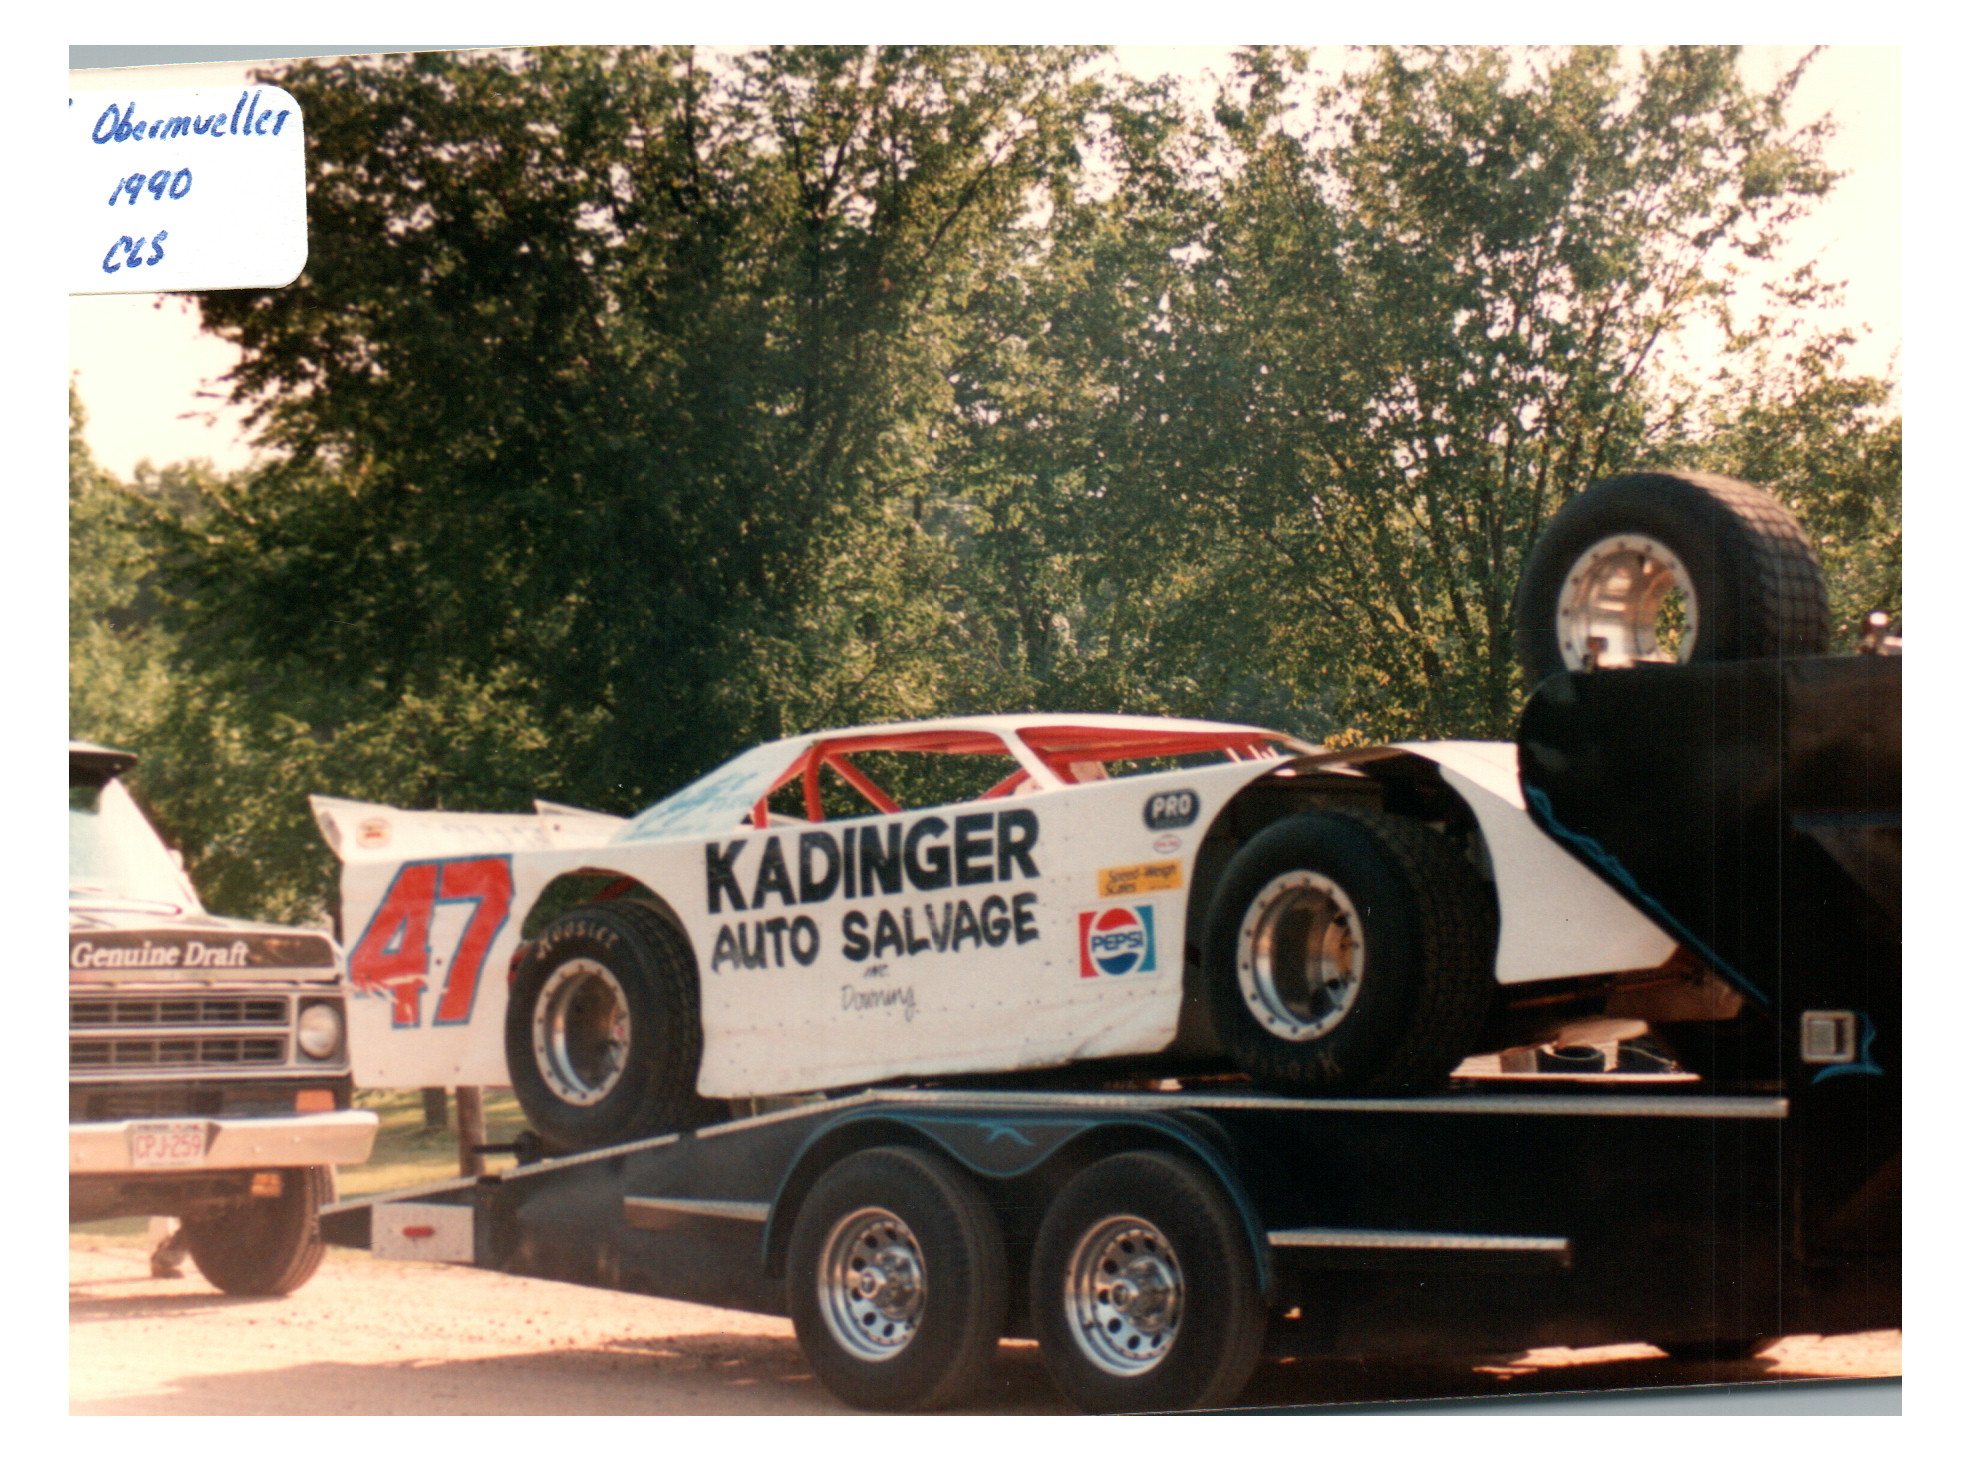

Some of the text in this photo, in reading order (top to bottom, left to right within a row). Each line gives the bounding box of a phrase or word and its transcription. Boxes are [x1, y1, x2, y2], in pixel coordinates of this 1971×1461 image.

[92, 90, 292, 144] Obermueller
[108, 168, 192, 206] 1990
[1152, 795, 1191, 819] PRO
[705, 808, 1040, 913] KADINGER
[70, 940, 250, 969] Genuine Draft
[347, 854, 515, 1029] 47
[711, 892, 1040, 974] AUTO SALVAGE
[1091, 931, 1143, 951] PEPSI
